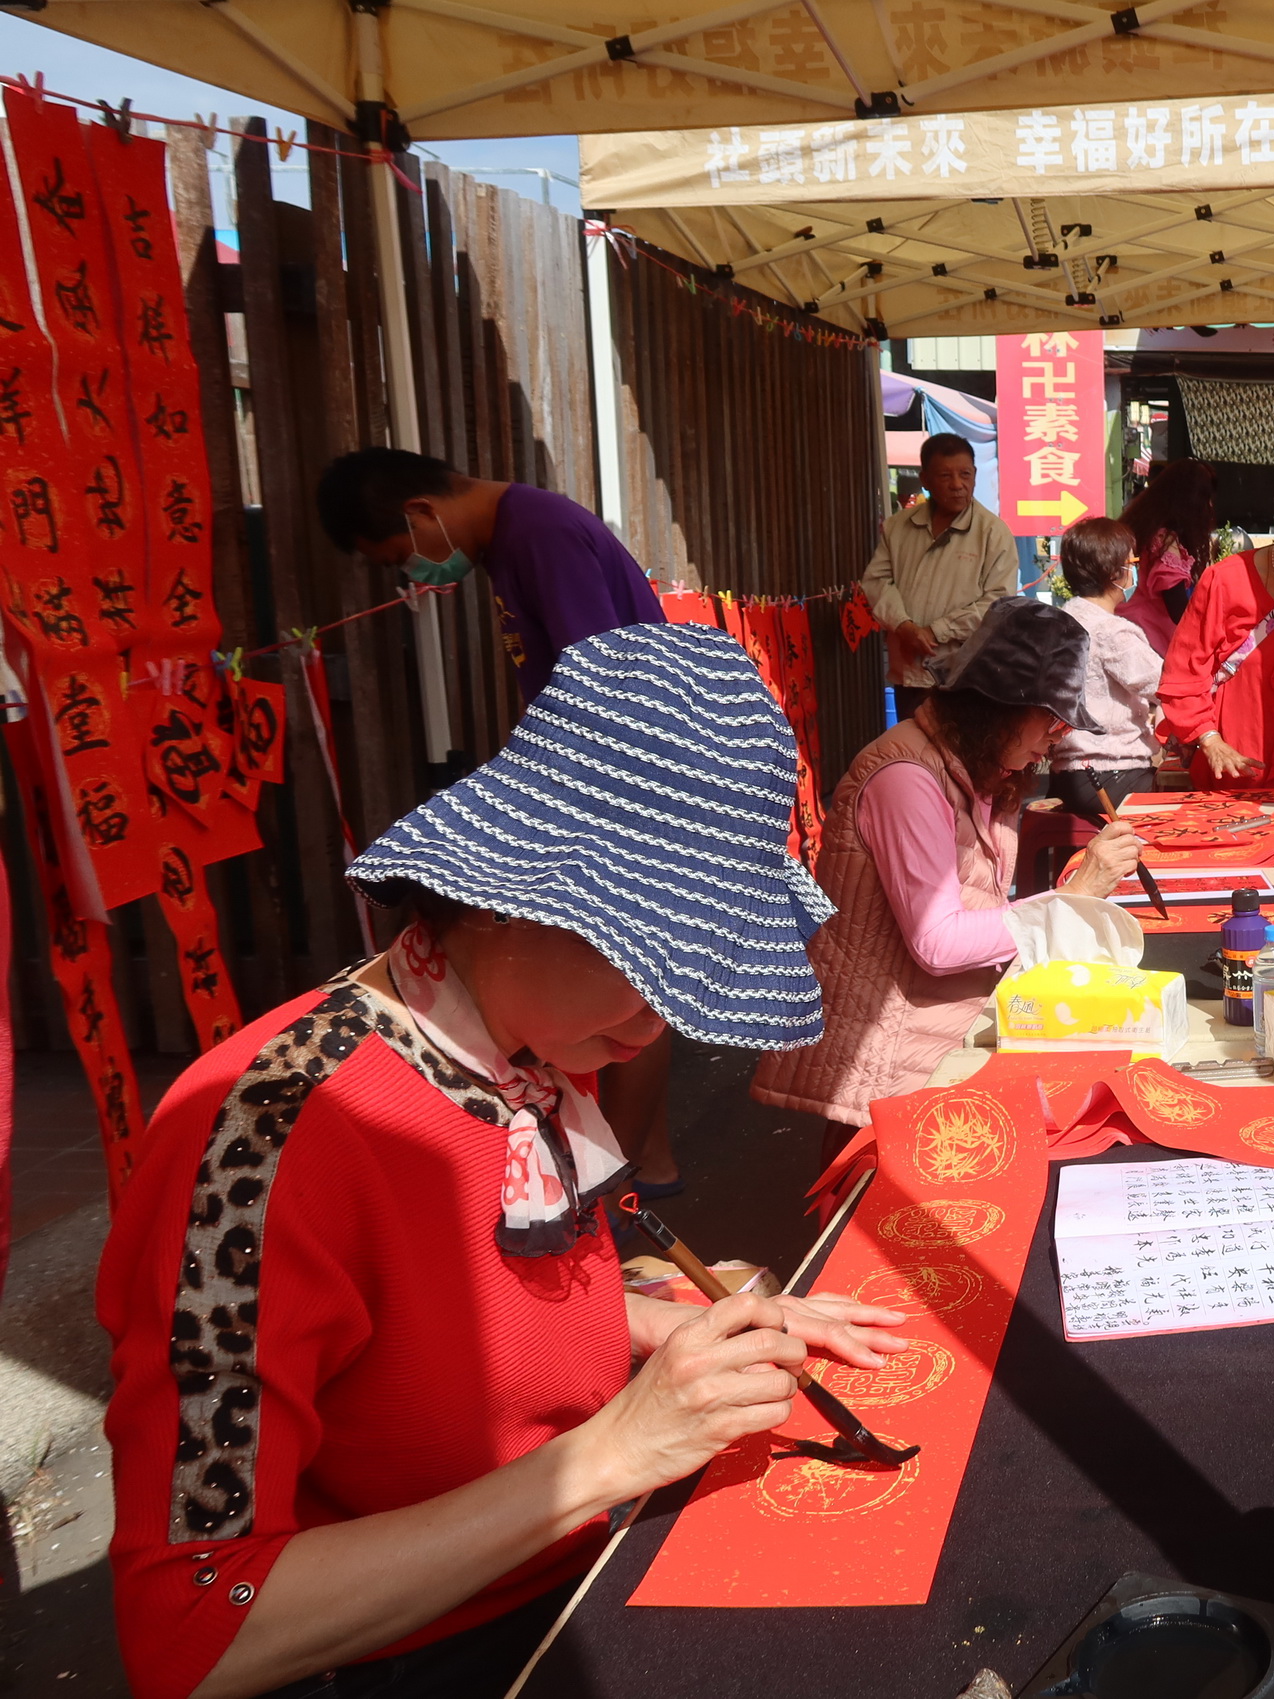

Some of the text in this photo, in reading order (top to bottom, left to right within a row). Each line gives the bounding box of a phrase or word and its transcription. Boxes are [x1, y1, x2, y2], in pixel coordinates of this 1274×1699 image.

[704, 114, 967, 188] 社頭新未來
